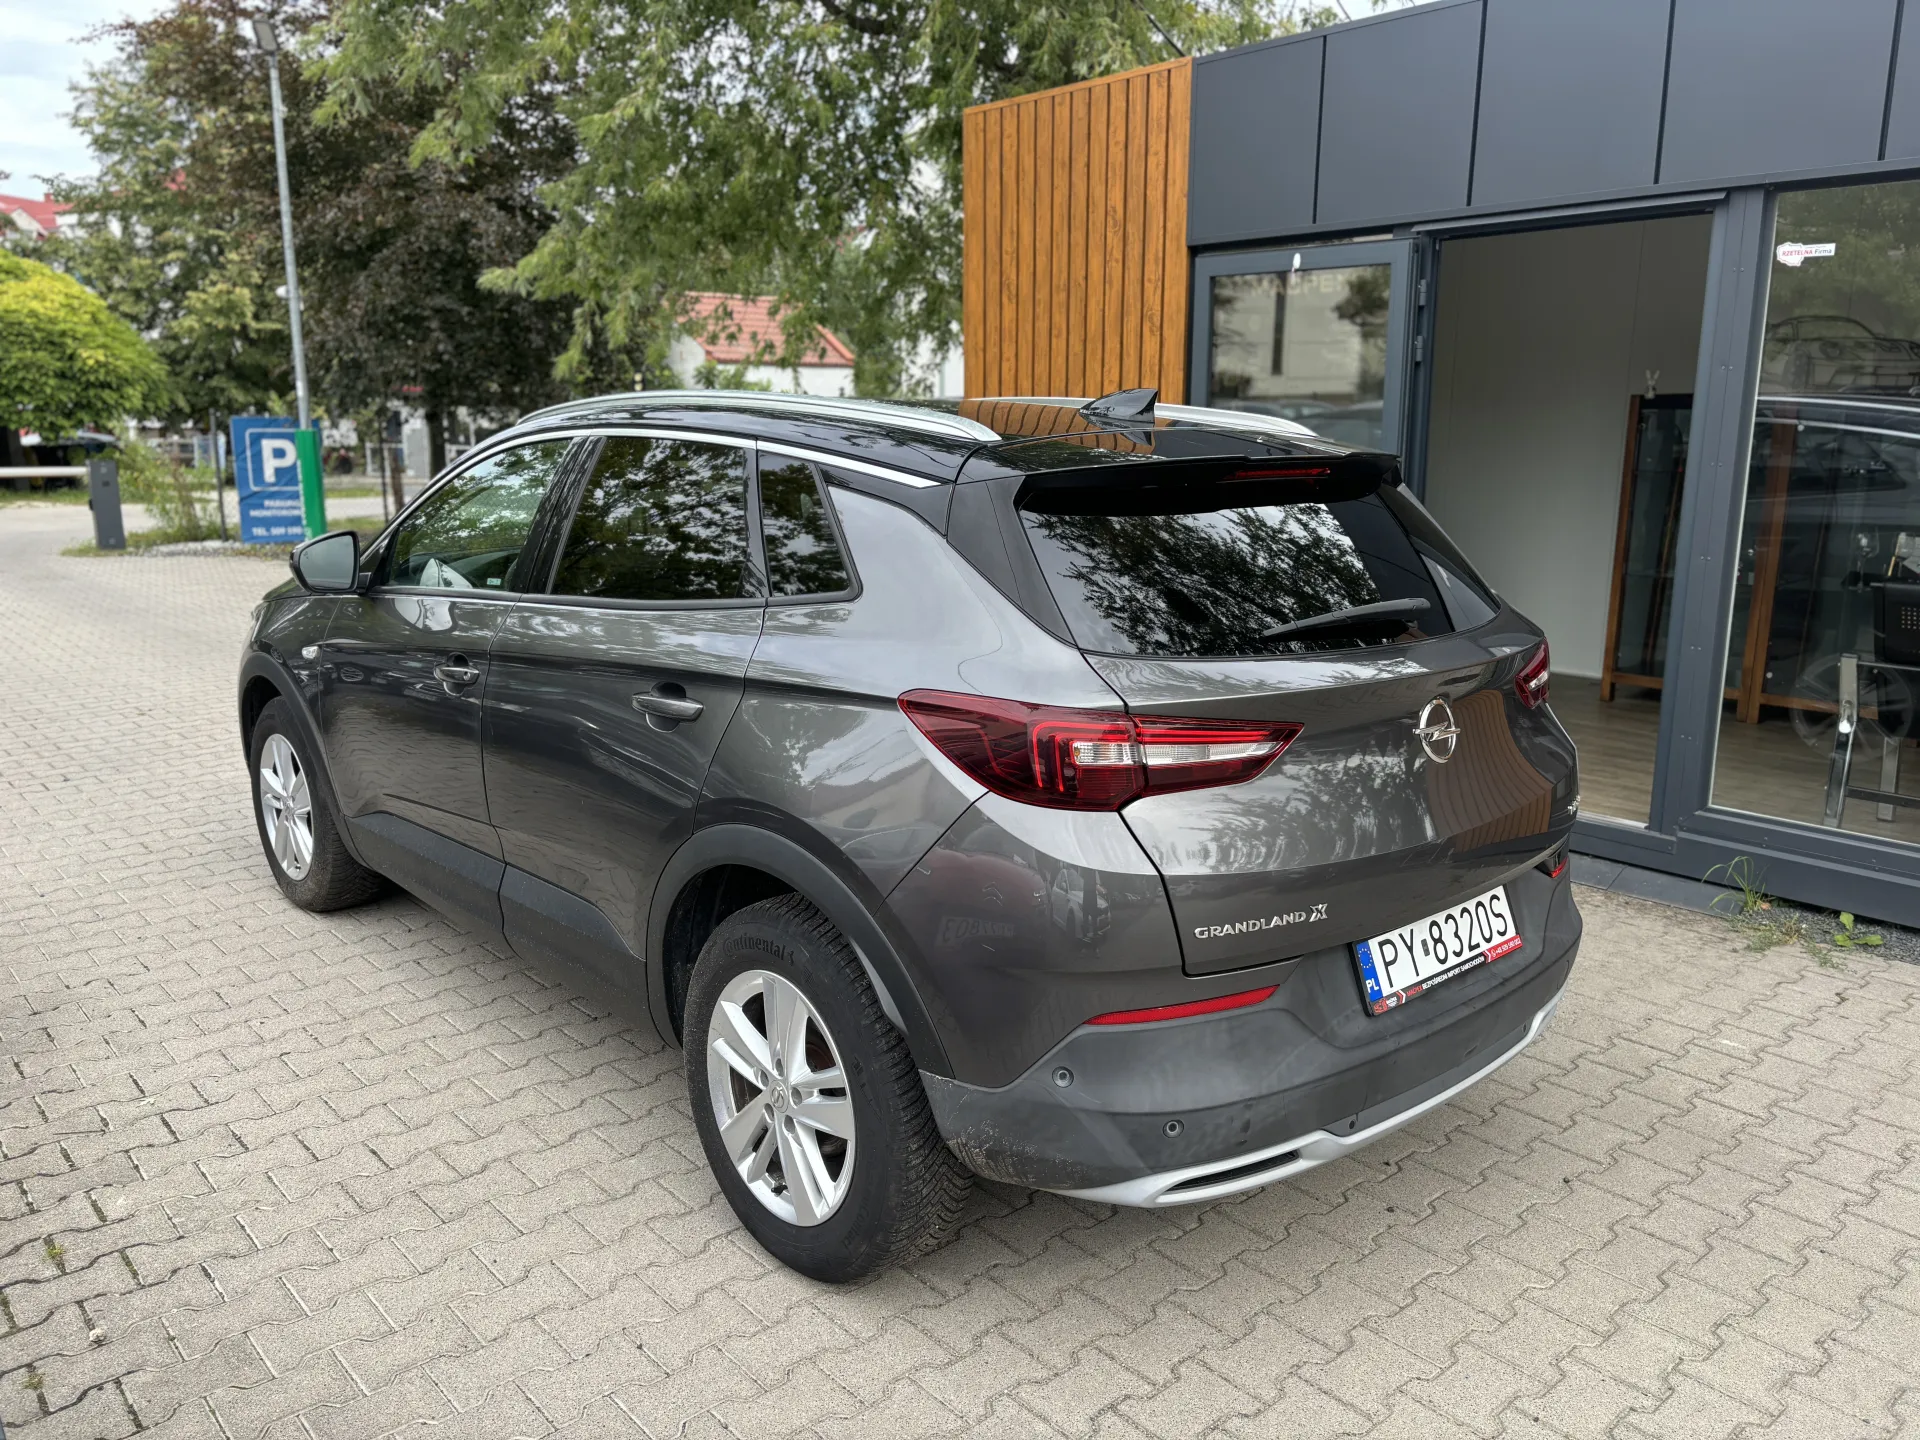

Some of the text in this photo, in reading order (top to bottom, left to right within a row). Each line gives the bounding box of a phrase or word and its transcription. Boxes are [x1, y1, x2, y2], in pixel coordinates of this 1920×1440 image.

[1782, 249, 1813, 257] RZETELNA
[261, 438, 298, 483] P
[1194, 903, 1328, 939] GRANDLAND X
[722, 932, 786, 960] Continental
[1378, 893, 1508, 988] PY 8320S
[1365, 977, 1380, 993] PL
